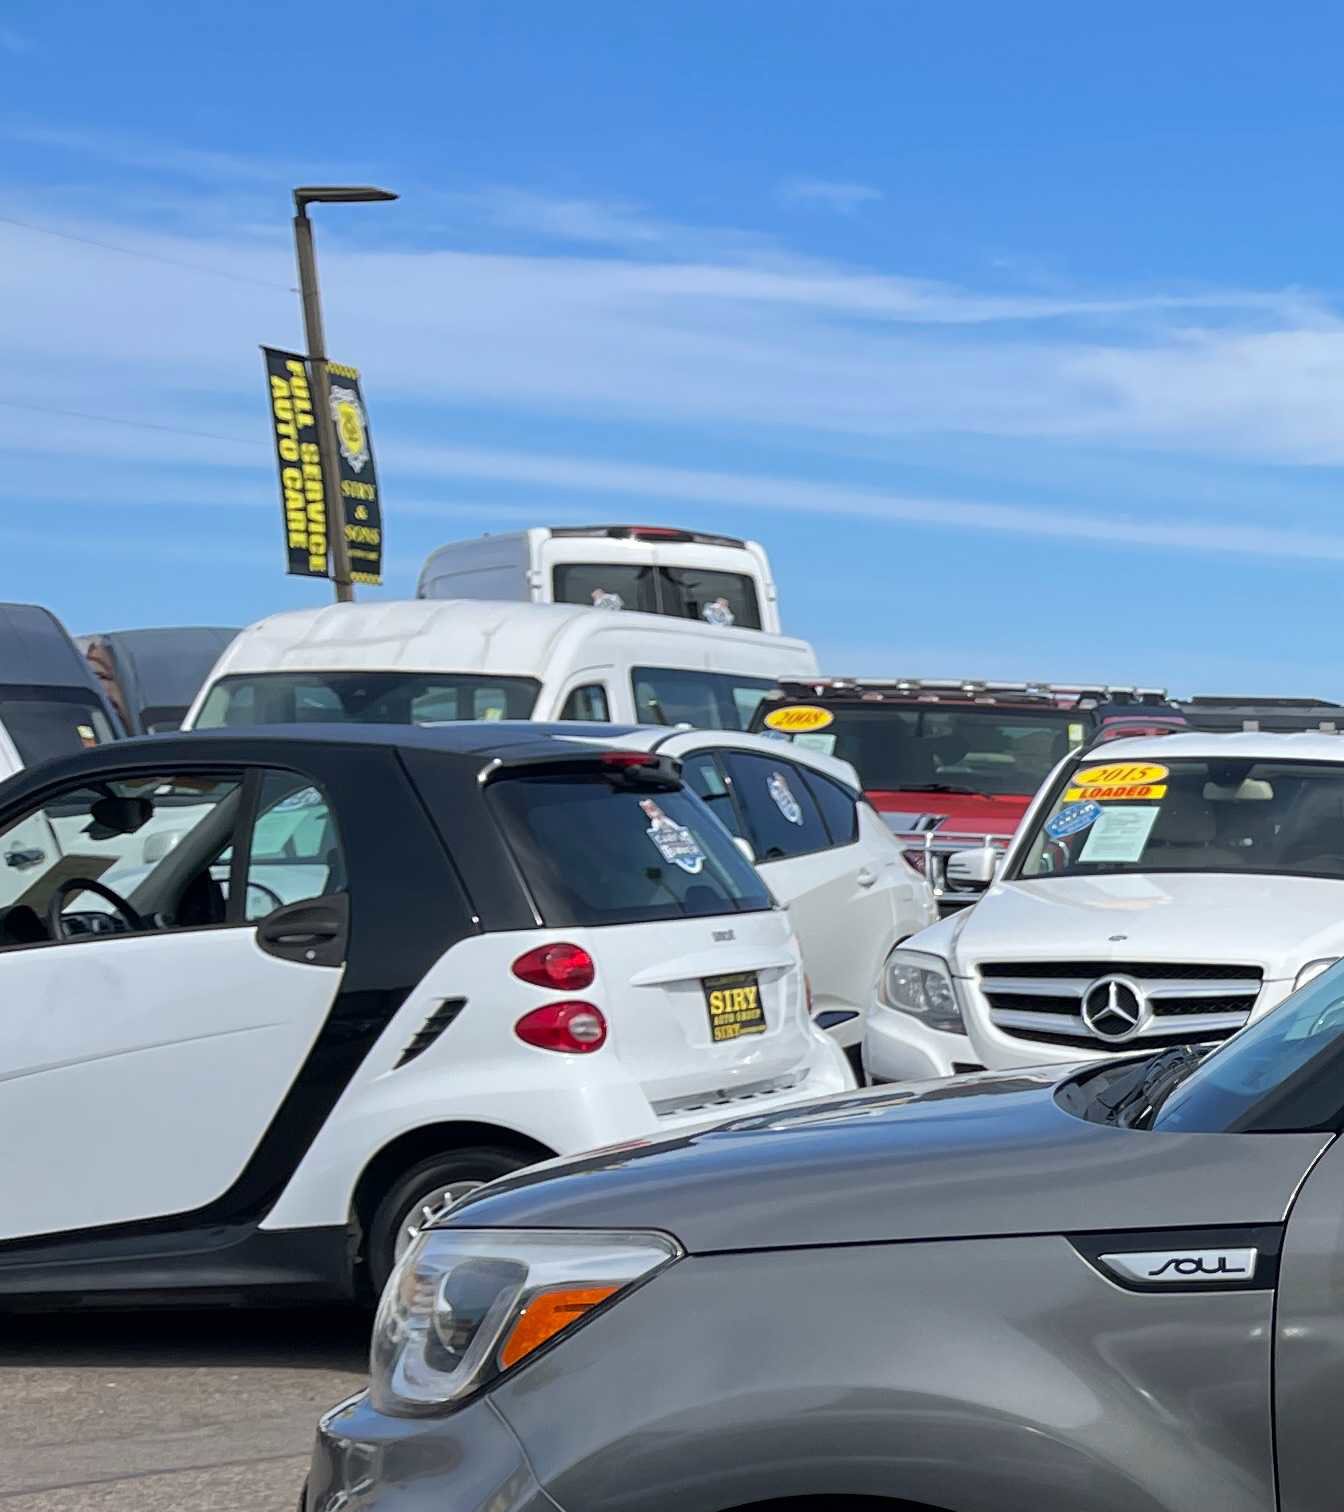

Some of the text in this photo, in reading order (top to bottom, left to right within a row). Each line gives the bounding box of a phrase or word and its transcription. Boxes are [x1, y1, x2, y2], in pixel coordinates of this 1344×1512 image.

[271, 375, 309, 549] AUTO CARE
[286, 360, 327, 572] FULL SERVICE
[1088, 767, 1153, 782] 2015
[1080, 785, 1152, 799] LOADED
[709, 986, 758, 1015] SIRY
[714, 1013, 735, 1026] AUTO
[1148, 1256, 1245, 1276] SOUL
